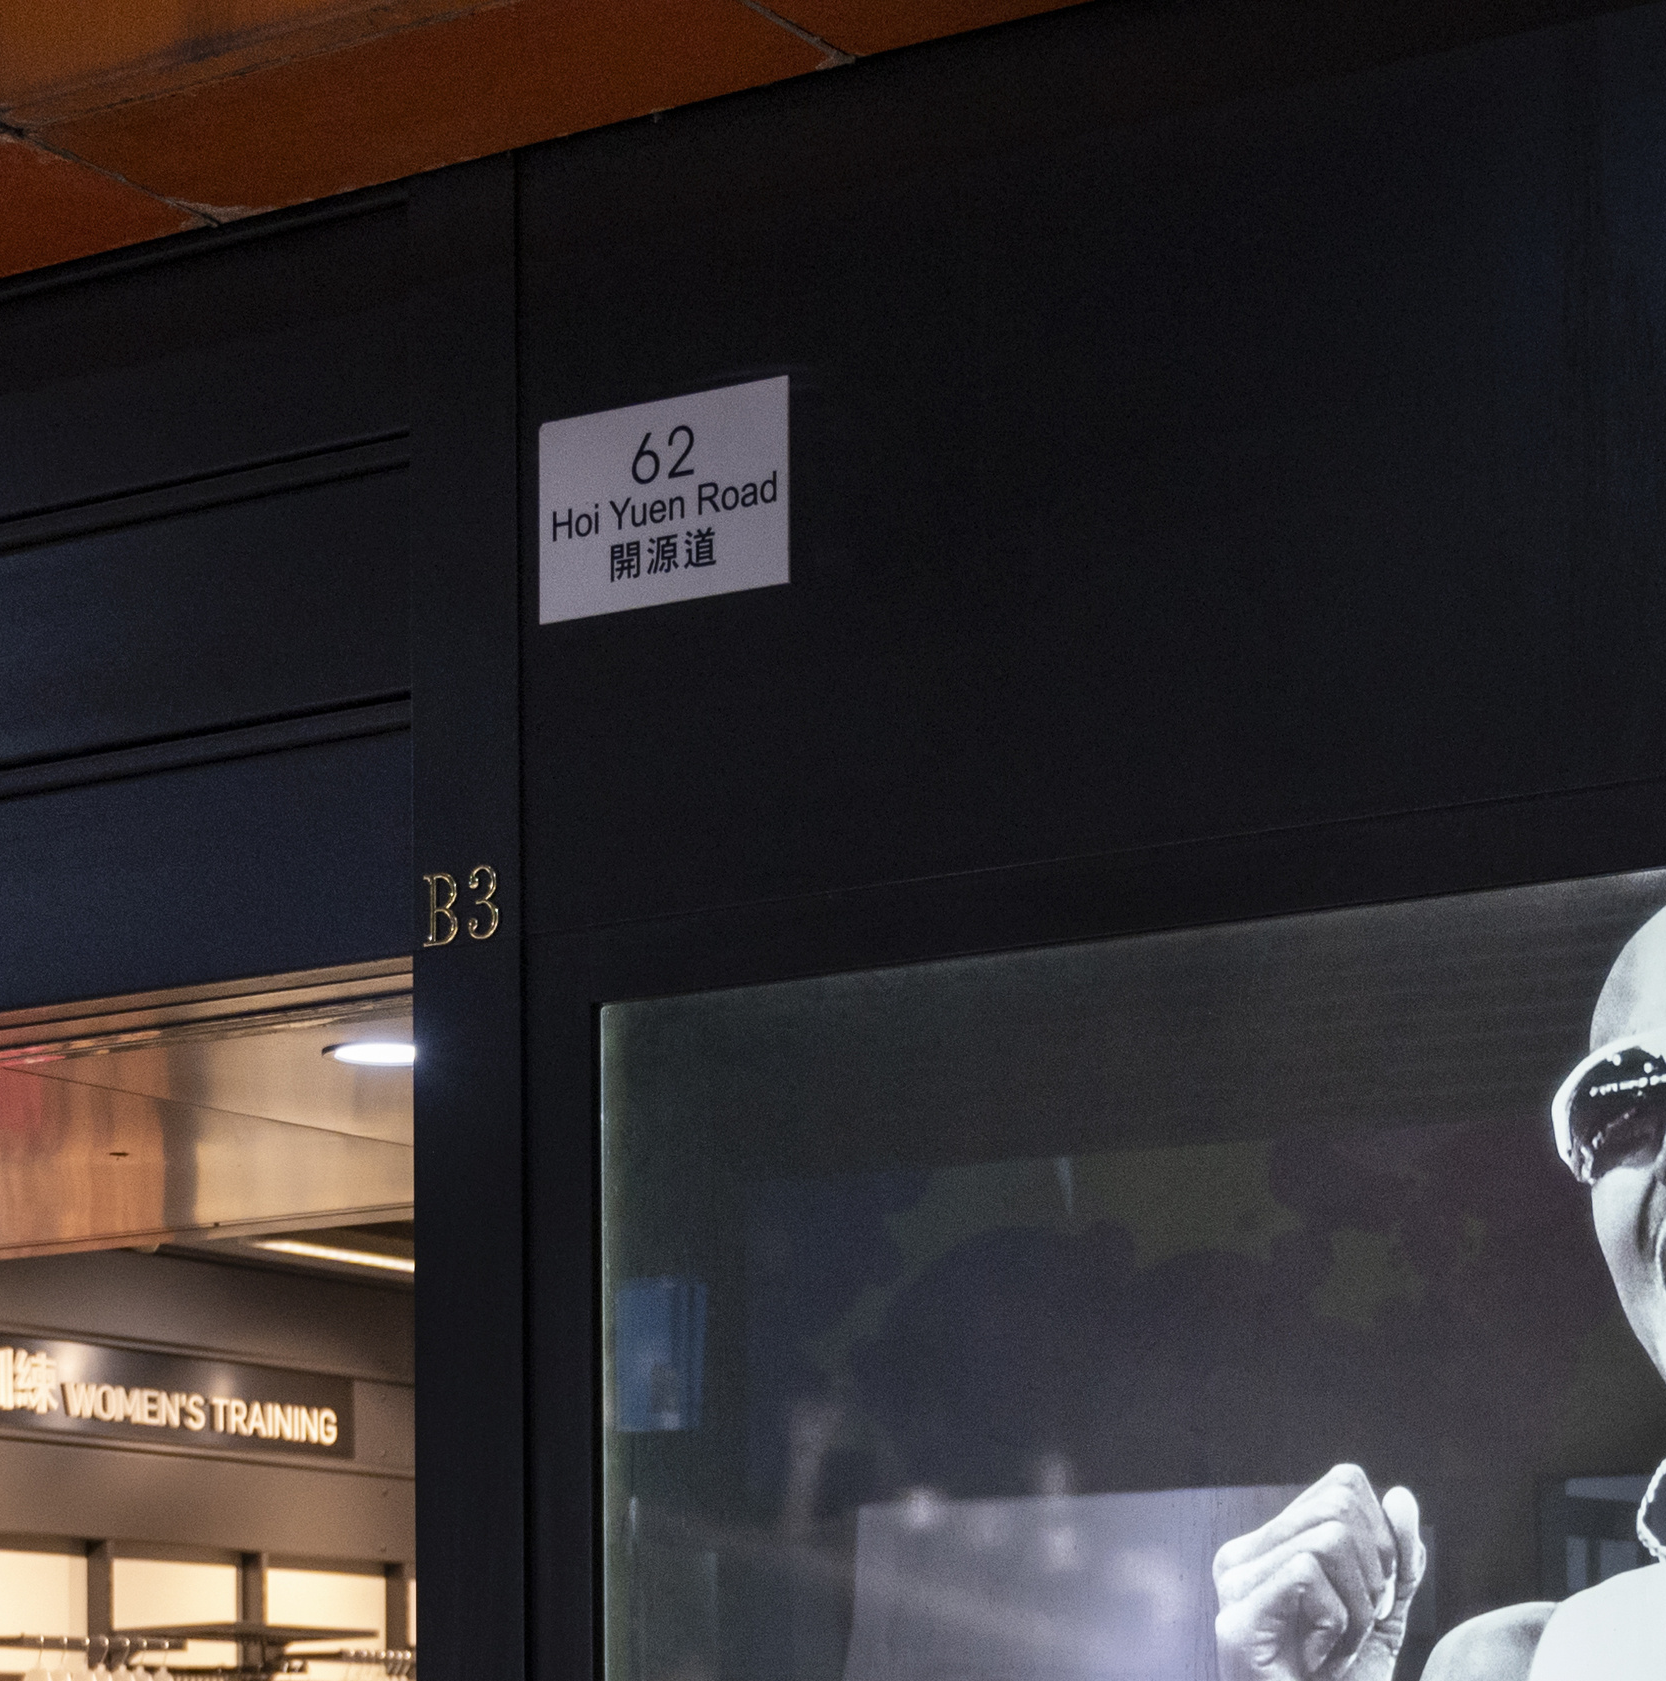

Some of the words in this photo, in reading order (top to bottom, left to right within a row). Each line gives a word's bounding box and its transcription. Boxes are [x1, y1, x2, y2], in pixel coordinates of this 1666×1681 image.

[632, 425, 695, 485] 62
[551, 504, 599, 542] Hoi
[610, 496, 685, 530] Yuen
[697, 471, 778, 515] Road
[610, 526, 717, 582] 開源道
[423, 865, 499, 948] B3
[61, 1382, 206, 1431] WOMEN'S
[210, 1397, 338, 1446] TRAINING
